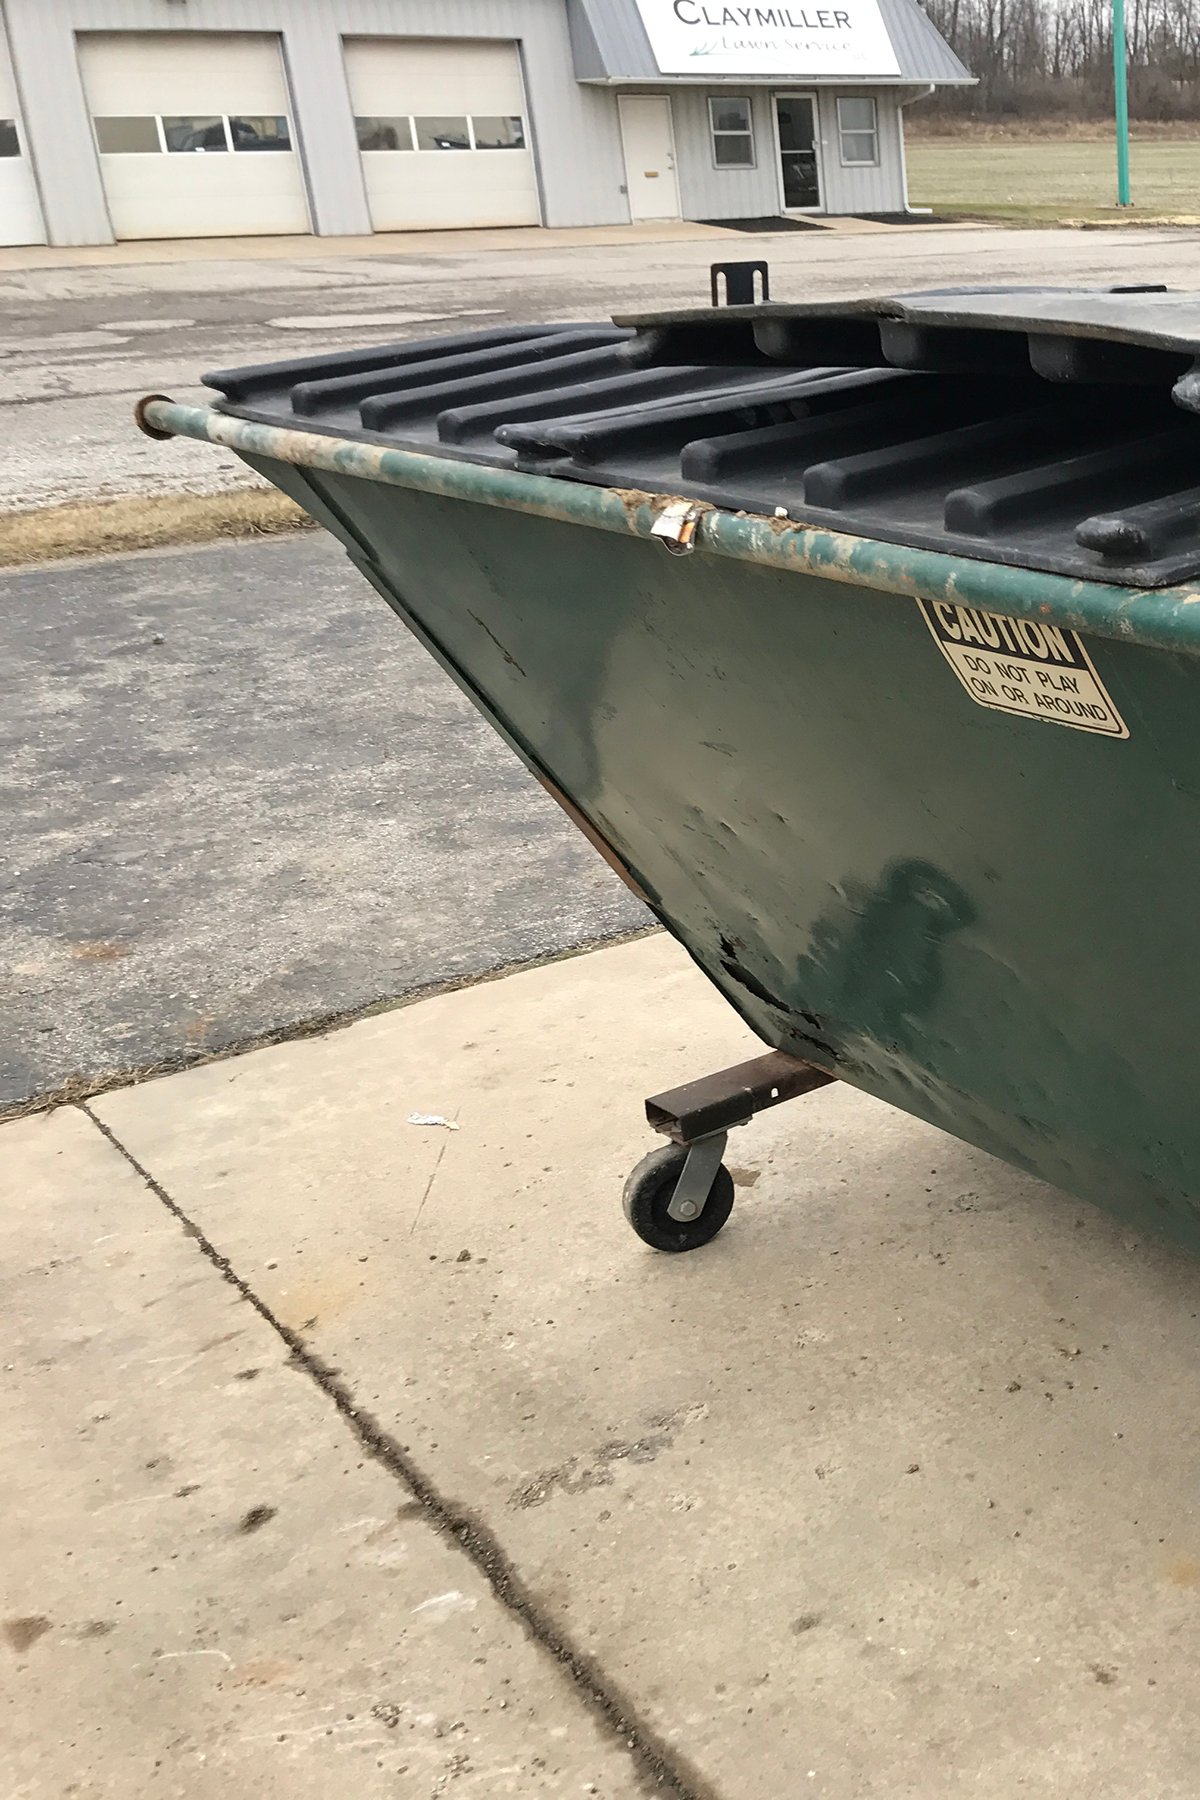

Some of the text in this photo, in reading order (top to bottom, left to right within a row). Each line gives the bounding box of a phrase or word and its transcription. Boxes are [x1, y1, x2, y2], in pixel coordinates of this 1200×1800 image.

[673, 0, 852, 29] CLAYMILLER
[722, 36, 778, 49] Lawn
[932, 601, 1075, 663] CAUTION
[962, 653, 1080, 694] DO NOT PLAY
[971, 677, 1108, 722] ON OR AROUND
